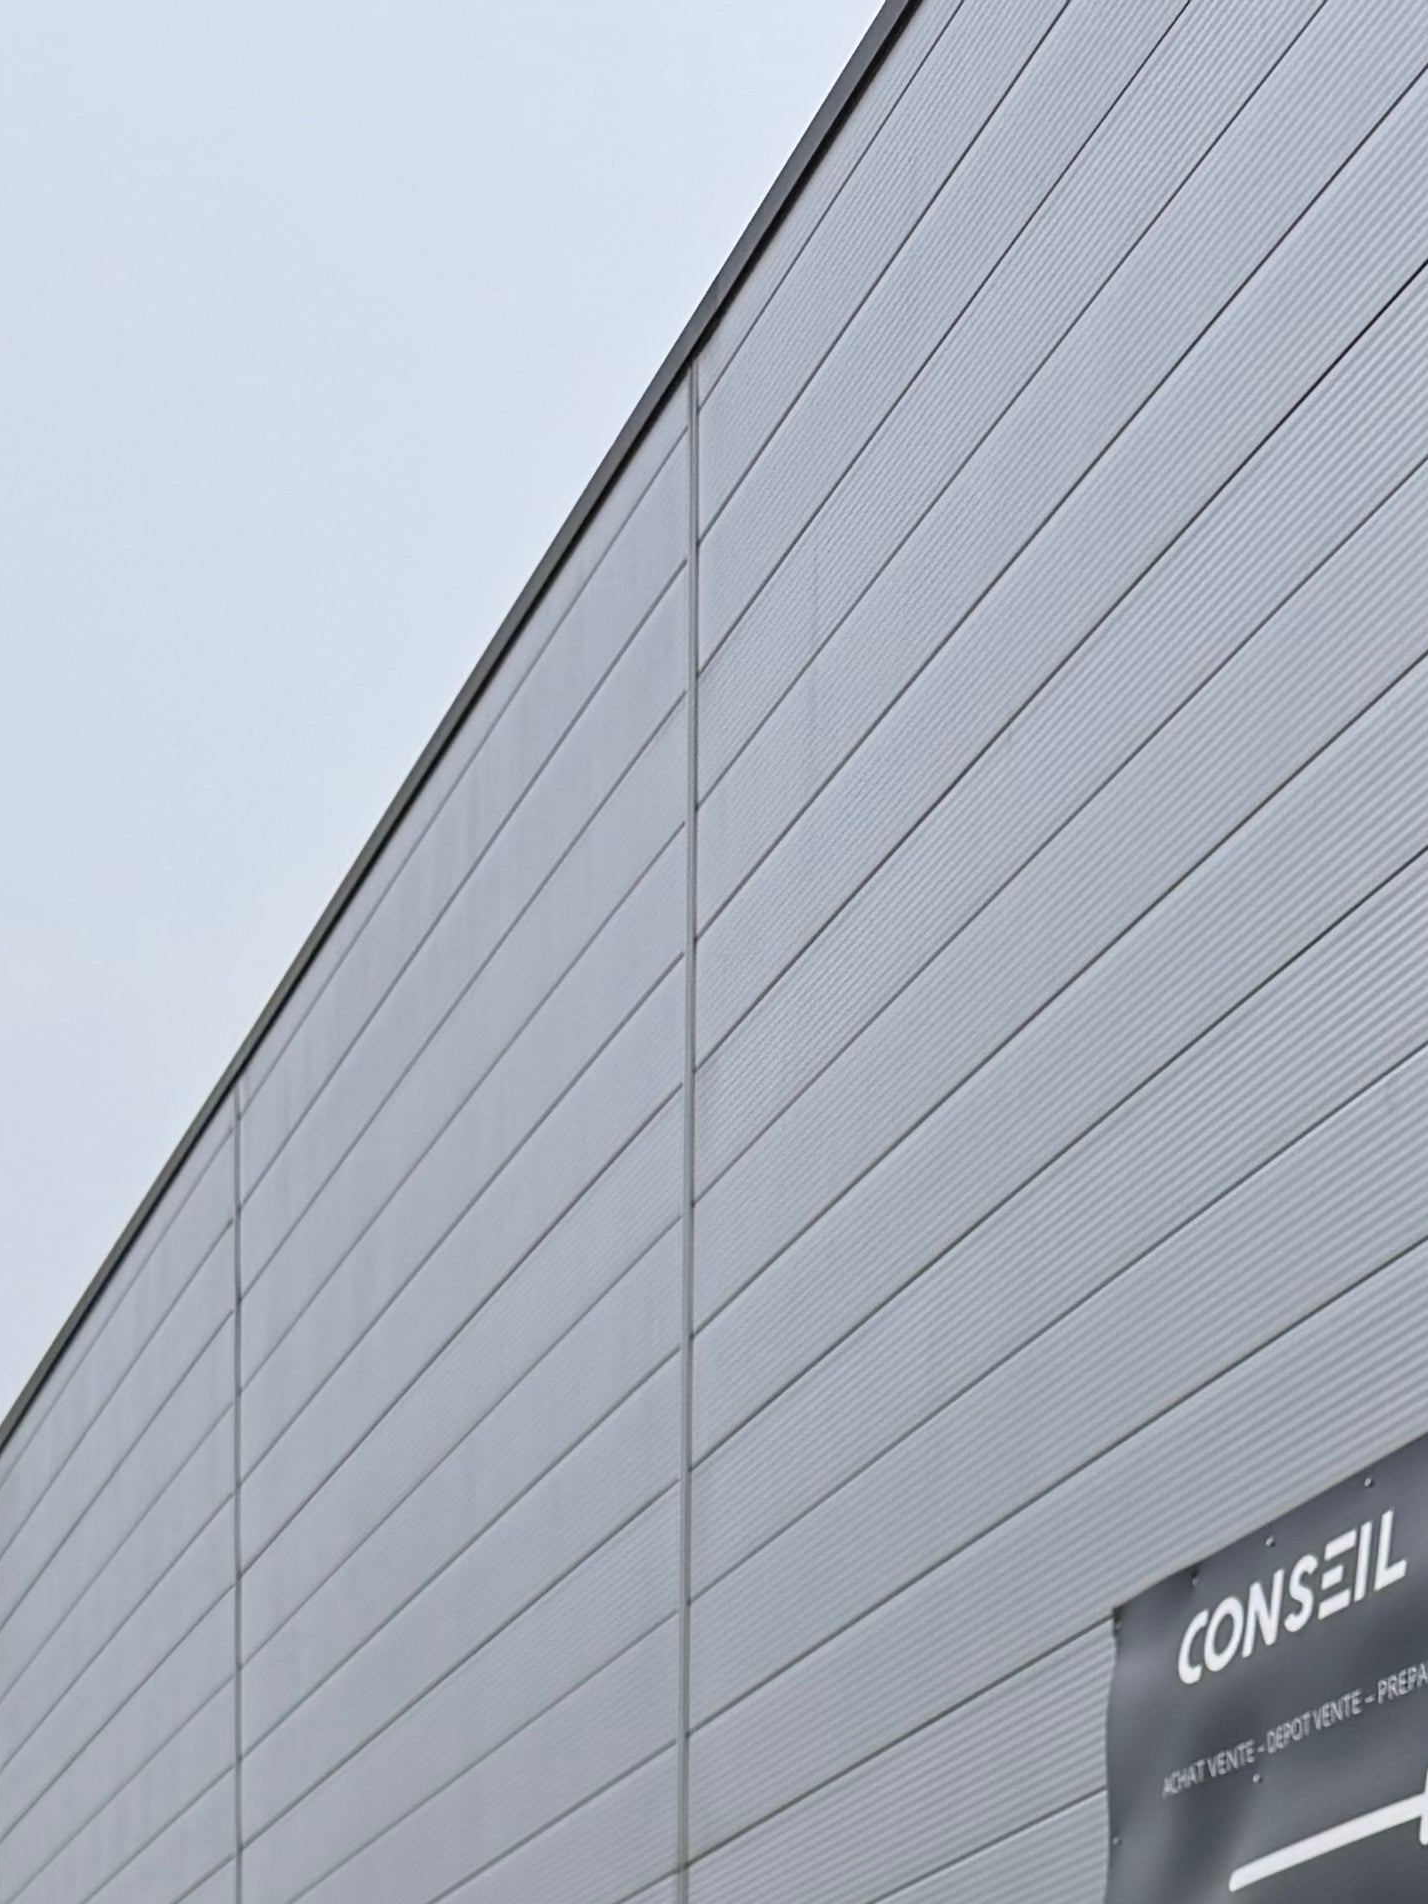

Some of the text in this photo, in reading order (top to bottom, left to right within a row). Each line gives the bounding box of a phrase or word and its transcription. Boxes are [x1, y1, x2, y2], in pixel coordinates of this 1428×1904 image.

[1178, 1507, 1408, 1685] CONSEIL
[1162, 1758, 1206, 1798] ACHAT
[1207, 1738, 1256, 1777] VENTE
[1266, 1711, 1312, 1754] DEPOT
[1312, 1688, 1363, 1730] VENTE
